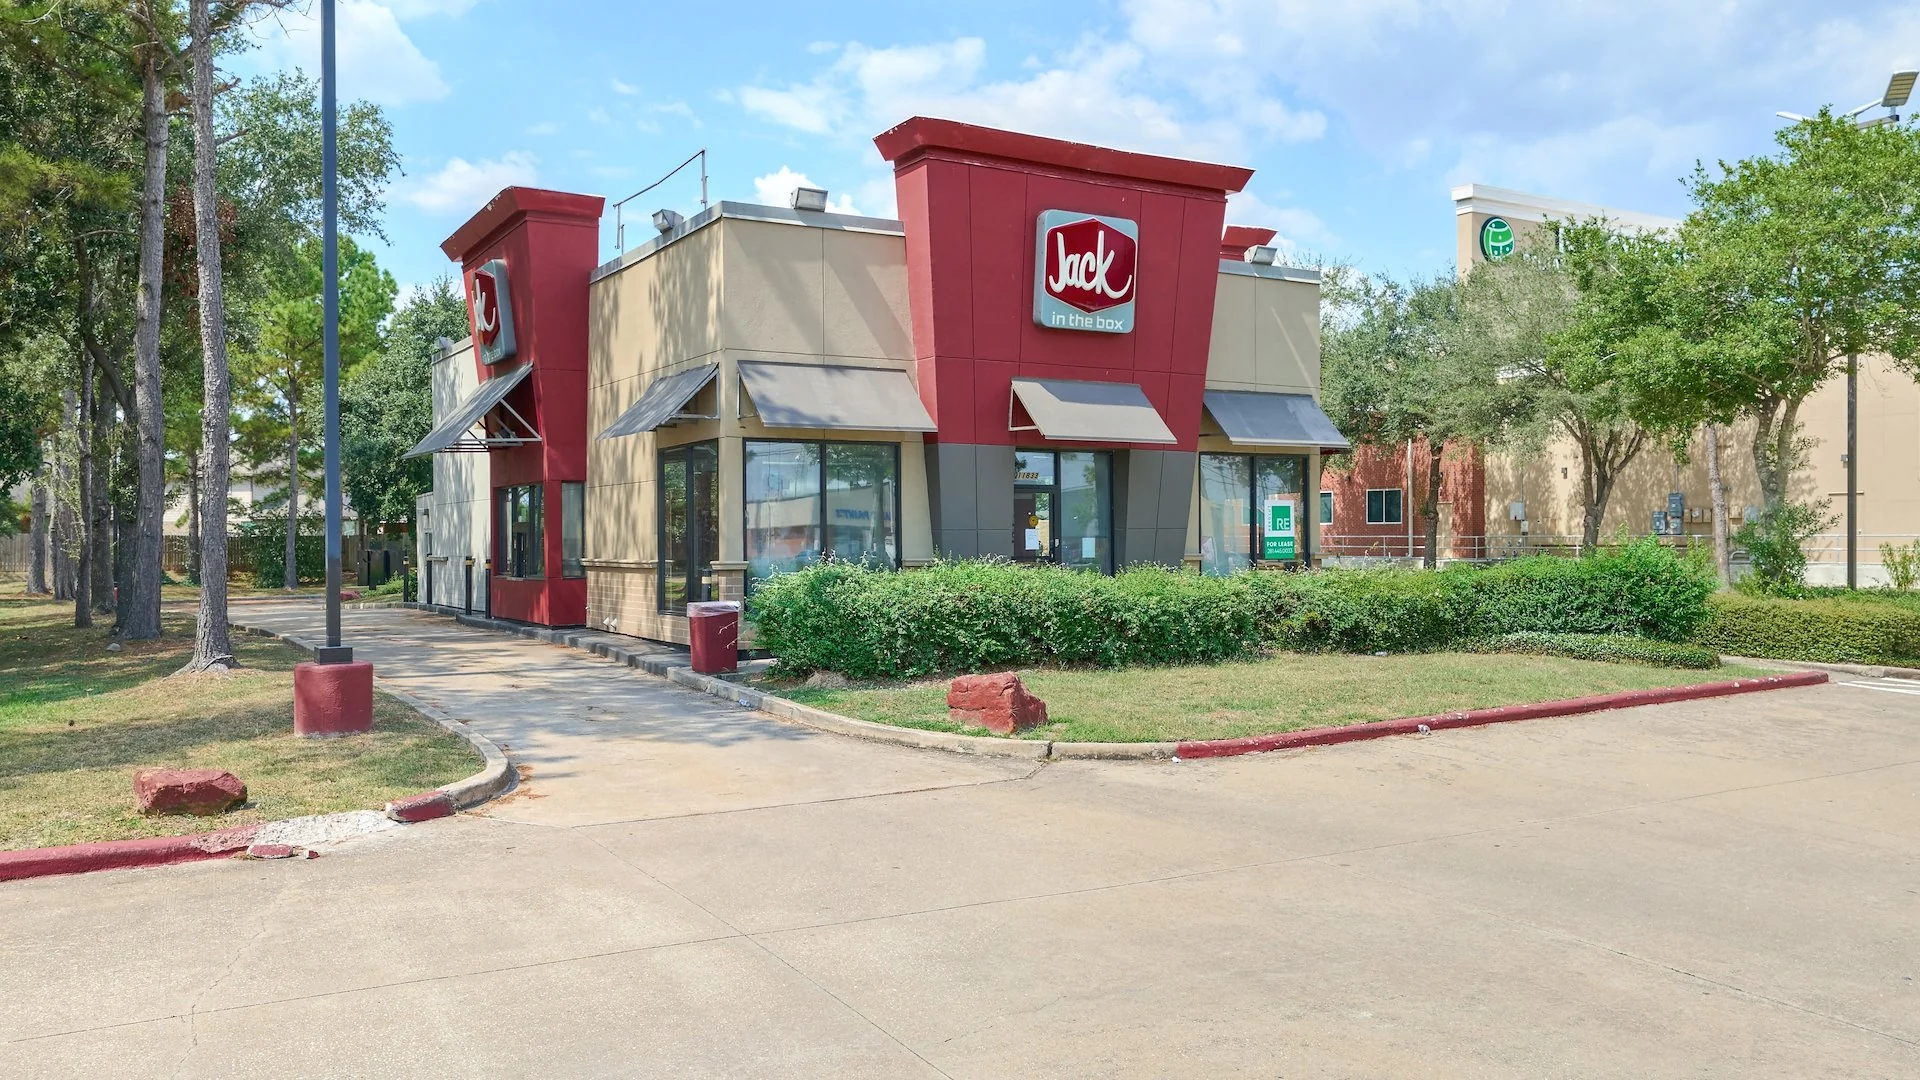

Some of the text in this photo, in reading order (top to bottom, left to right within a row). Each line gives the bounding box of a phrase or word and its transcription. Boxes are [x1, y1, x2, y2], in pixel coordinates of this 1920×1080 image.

[1049, 230, 1132, 299] Jack
[1052, 312, 1123, 330] in the box
[1276, 517, 1290, 530] RE
